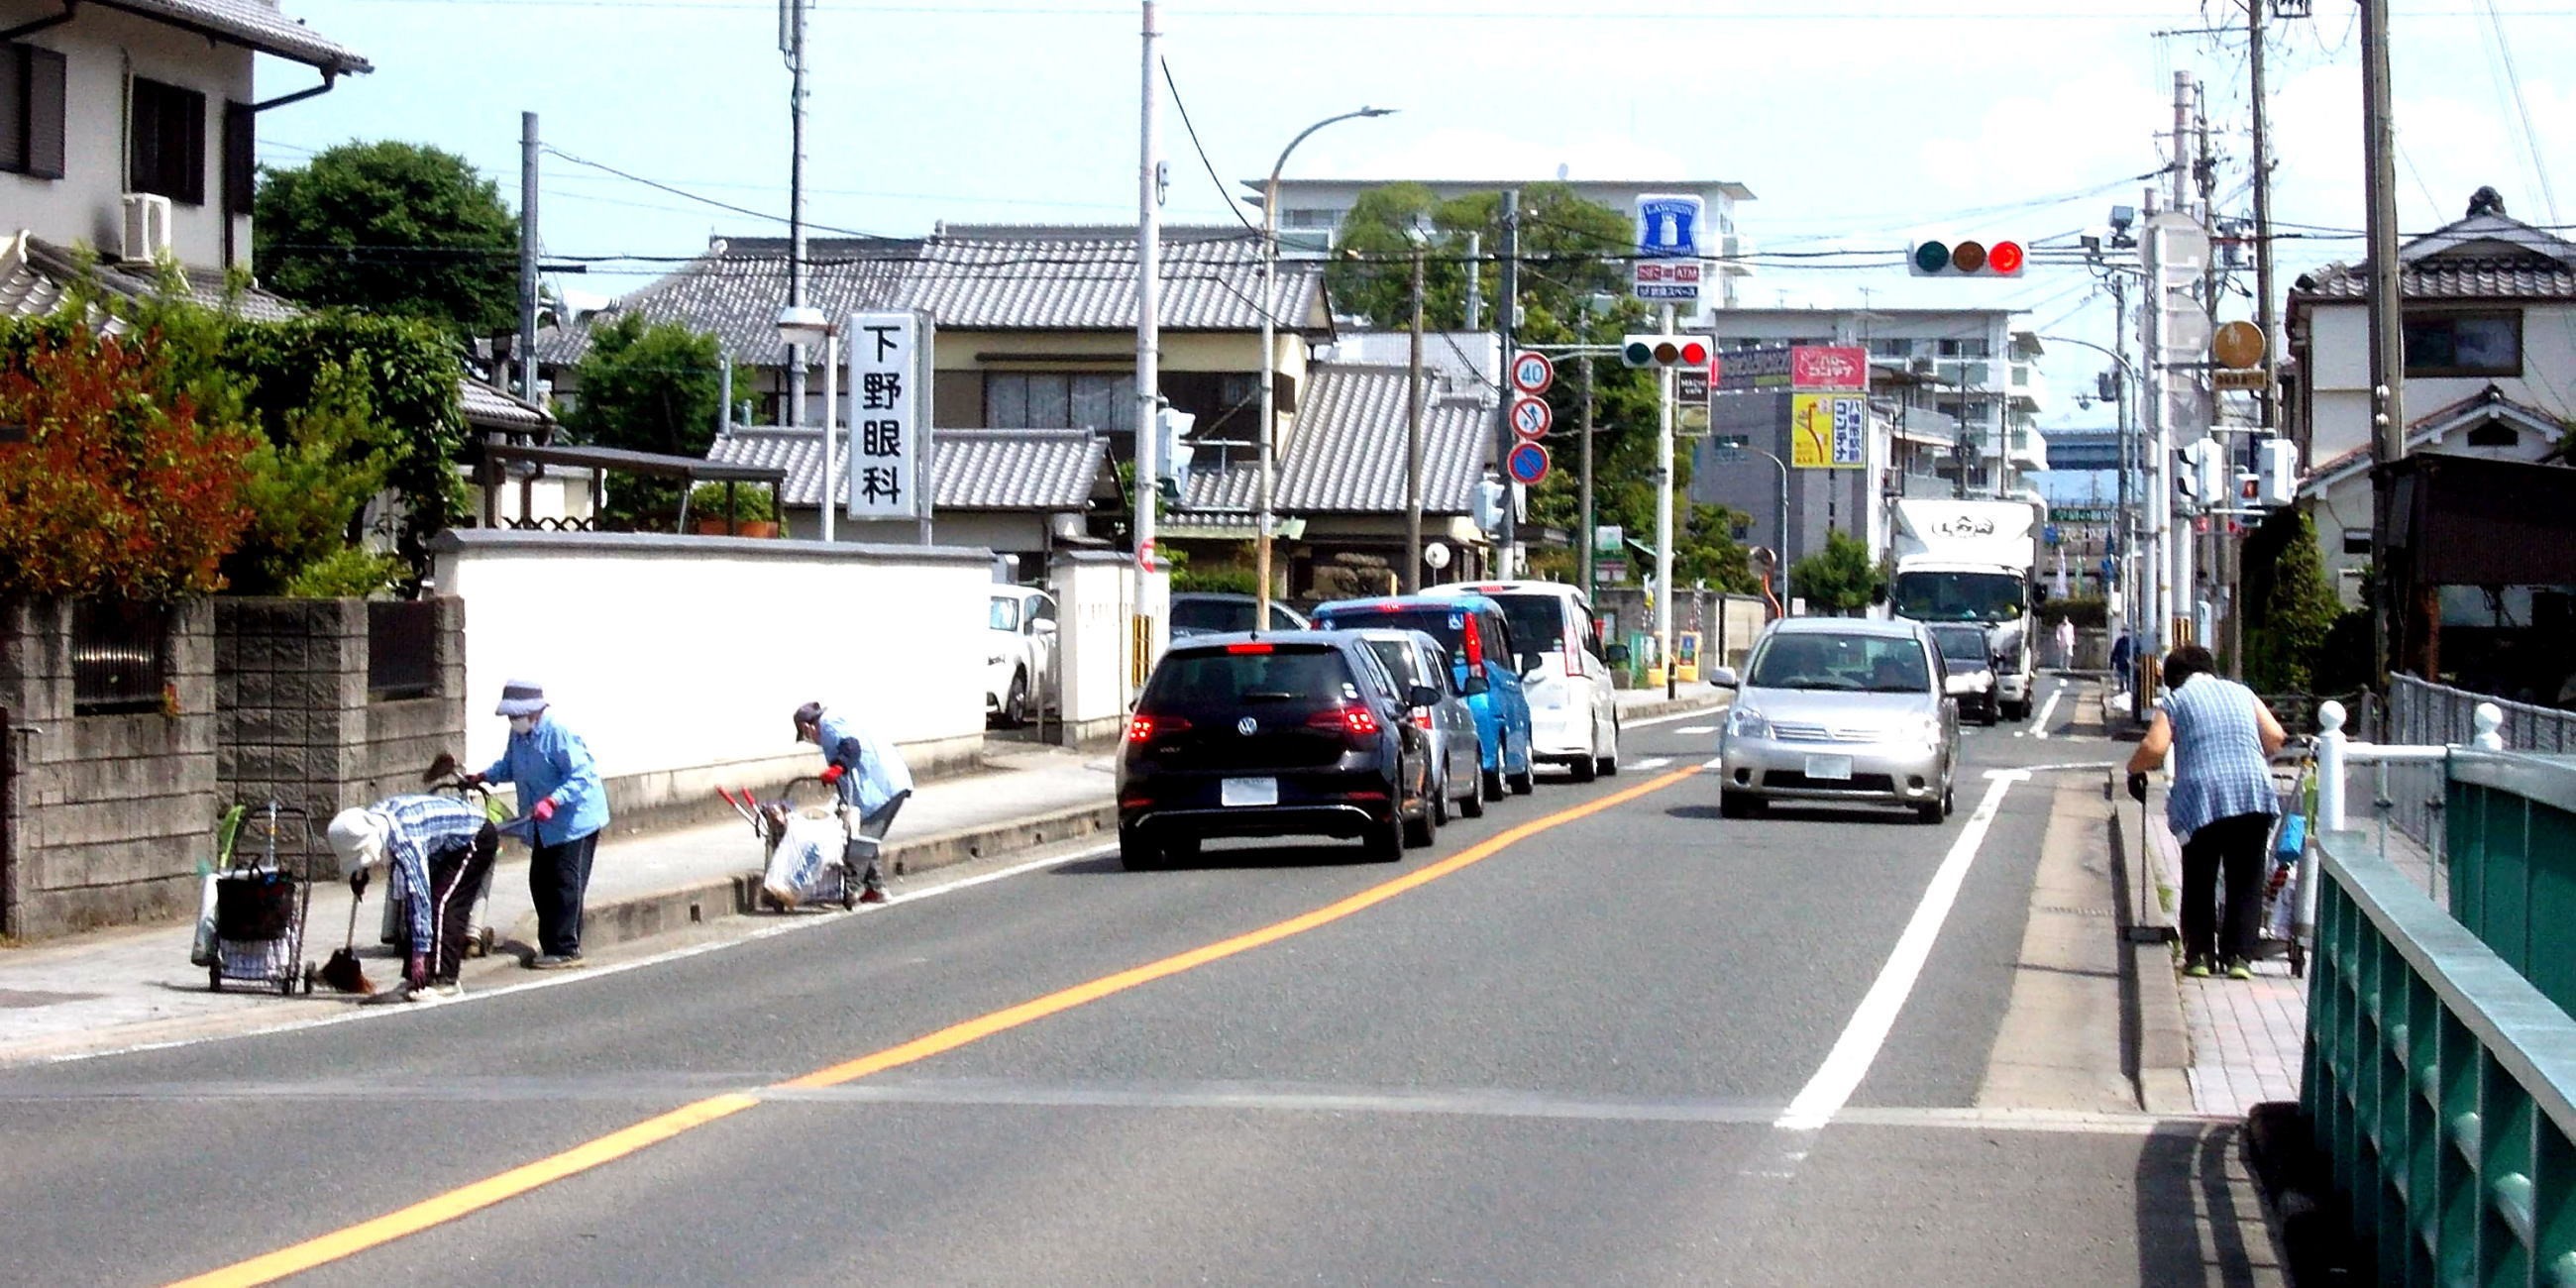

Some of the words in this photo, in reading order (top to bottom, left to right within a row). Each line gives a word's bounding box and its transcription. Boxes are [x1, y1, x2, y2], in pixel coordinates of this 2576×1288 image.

[1676, 268, 1697, 279] ATM
[1521, 364, 1545, 383] 40
[862, 325, 902, 505] 下野眼科
[1836, 401, 1848, 461] コンテナ
